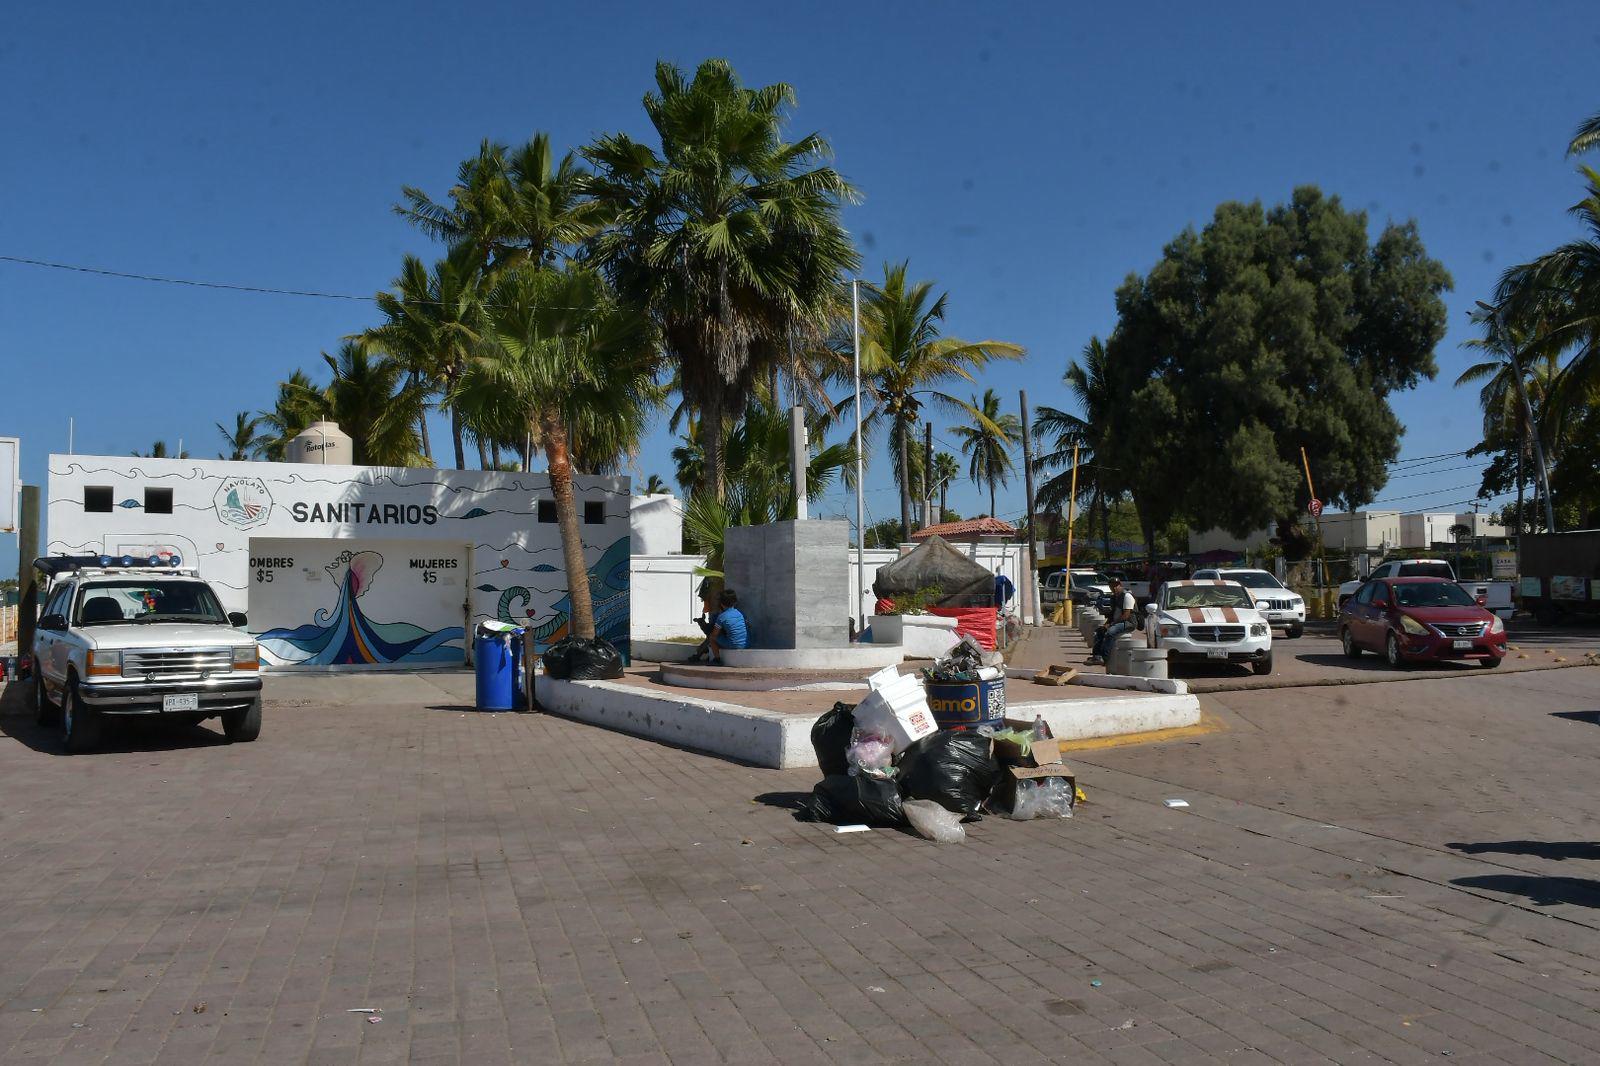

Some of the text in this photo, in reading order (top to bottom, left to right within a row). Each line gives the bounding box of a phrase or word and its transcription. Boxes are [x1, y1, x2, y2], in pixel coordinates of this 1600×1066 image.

[224, 480, 265, 495] NAVOLATO
[292, 501, 438, 525] SANITARIOS
[409, 558, 458, 569] MUJERES
[256, 568, 274, 584] $5
[423, 570, 438, 584] $5
